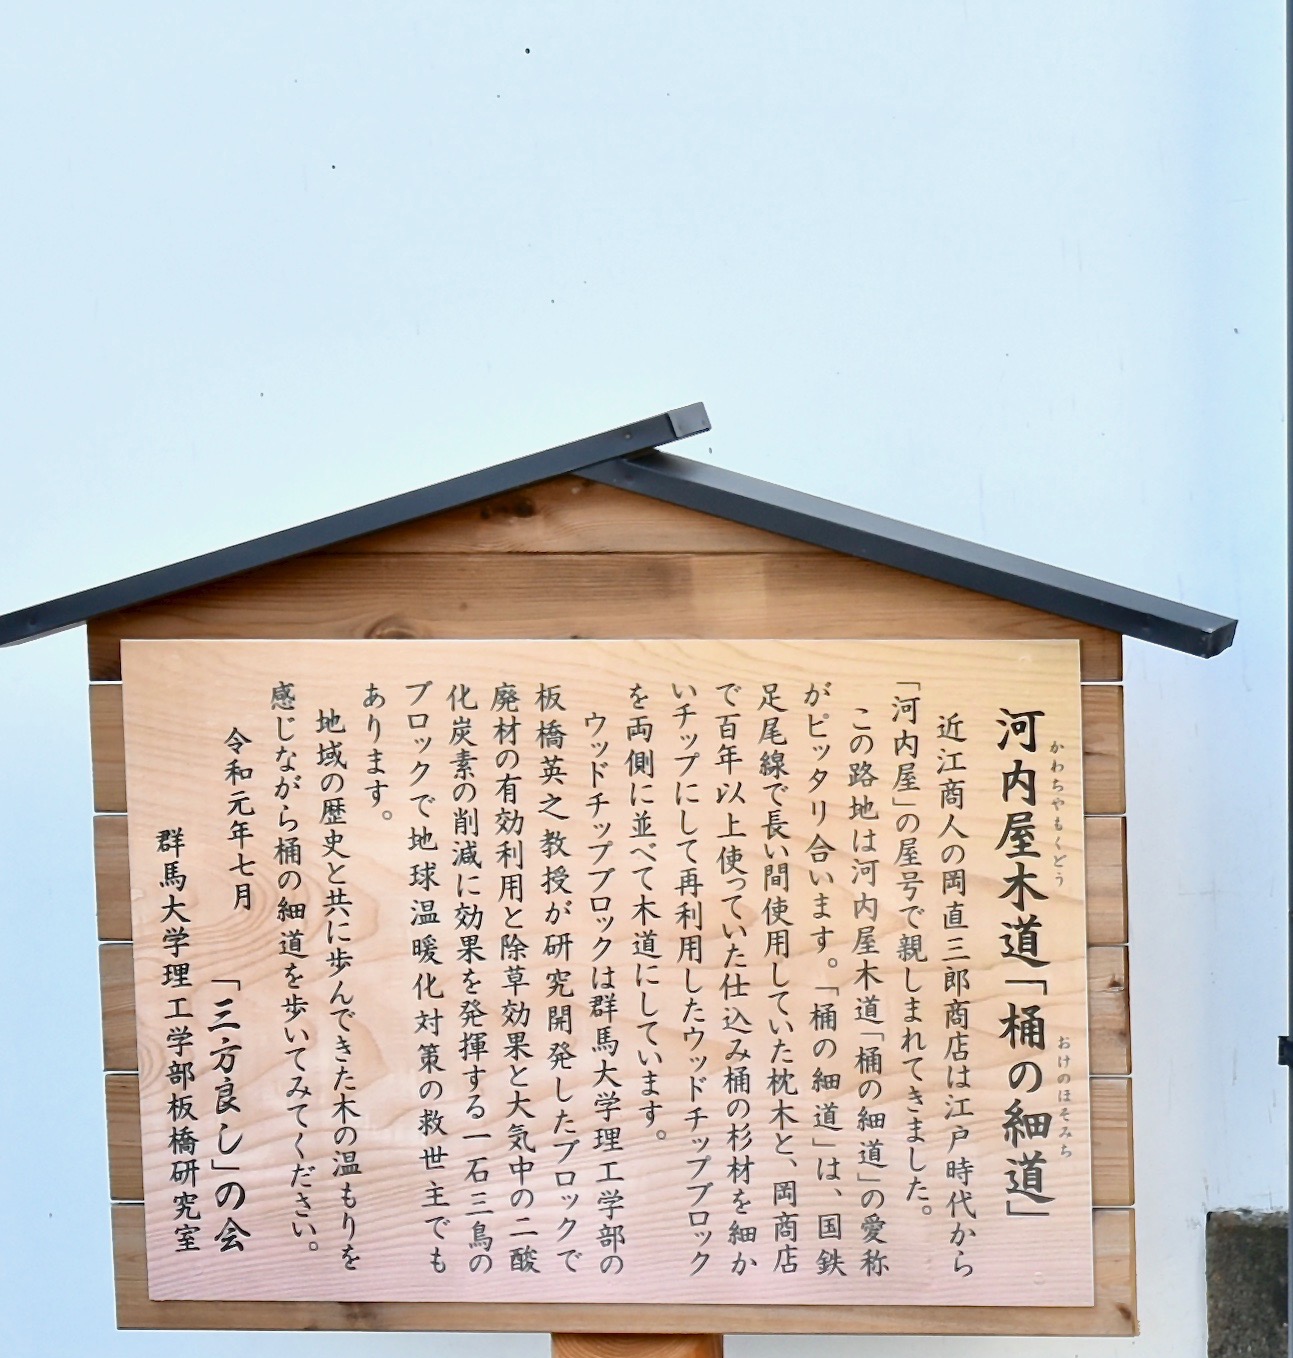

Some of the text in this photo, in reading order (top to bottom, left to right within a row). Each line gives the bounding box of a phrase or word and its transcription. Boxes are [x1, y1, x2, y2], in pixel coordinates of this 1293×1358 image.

[223, 727, 256, 911] 令和元年七月
[270, 681, 319, 1251] 感じながら桶の細道を歩いてみてください。
[315, 708, 362, 1271] 地域の歴史と共に歩んできた木の温もりを
[362, 682, 393, 821] あります。
[405, 680, 451, 1273] ブロックで地球温暖化対策の救世主でも
[446, 683, 494, 1274] 化炭素の削減に効果を発揮する一石三鳥の
[489, 681, 541, 1274] 廃材の有効利用と除草効果と大気中の二酸
[534, 682, 582, 1273] 板橋英之教授が研究開発したブロックで
[584, 711, 626, 1275] ウッドチップブロックは群馬大学理工学部の
[624, 682, 667, 1141] を両側に並べて木道にしています。
[671, 682, 714, 1276] いチップにして再利用したウッドチップブロック
[714, 682, 757, 1276] で百年以上使っていた仕込み桶の杉材を細か
[757, 682, 799, 1274] 足尾線で長い間使用していた枕木と、岡商店
[848, 707, 889, 1277] この路地は河内屋木道「桶の細道」の愛称
[891, 681, 932, 1216] 「河内屋」の屋号で親しまれてきました。
[936, 711, 977, 1277] 近江商人の岡直三郎商店は江戸時代から
[995, 707, 1055, 1217] 河内屋木道「桶の細道」
[1049, 740, 1067, 887] かわちやもくどう
[156, 827, 201, 1253] 群馬大学理工学部板橋研究室
[207, 979, 251, 1253] 「三方良し」の会
[1057, 1035, 1073, 1159] おけのほそみち
